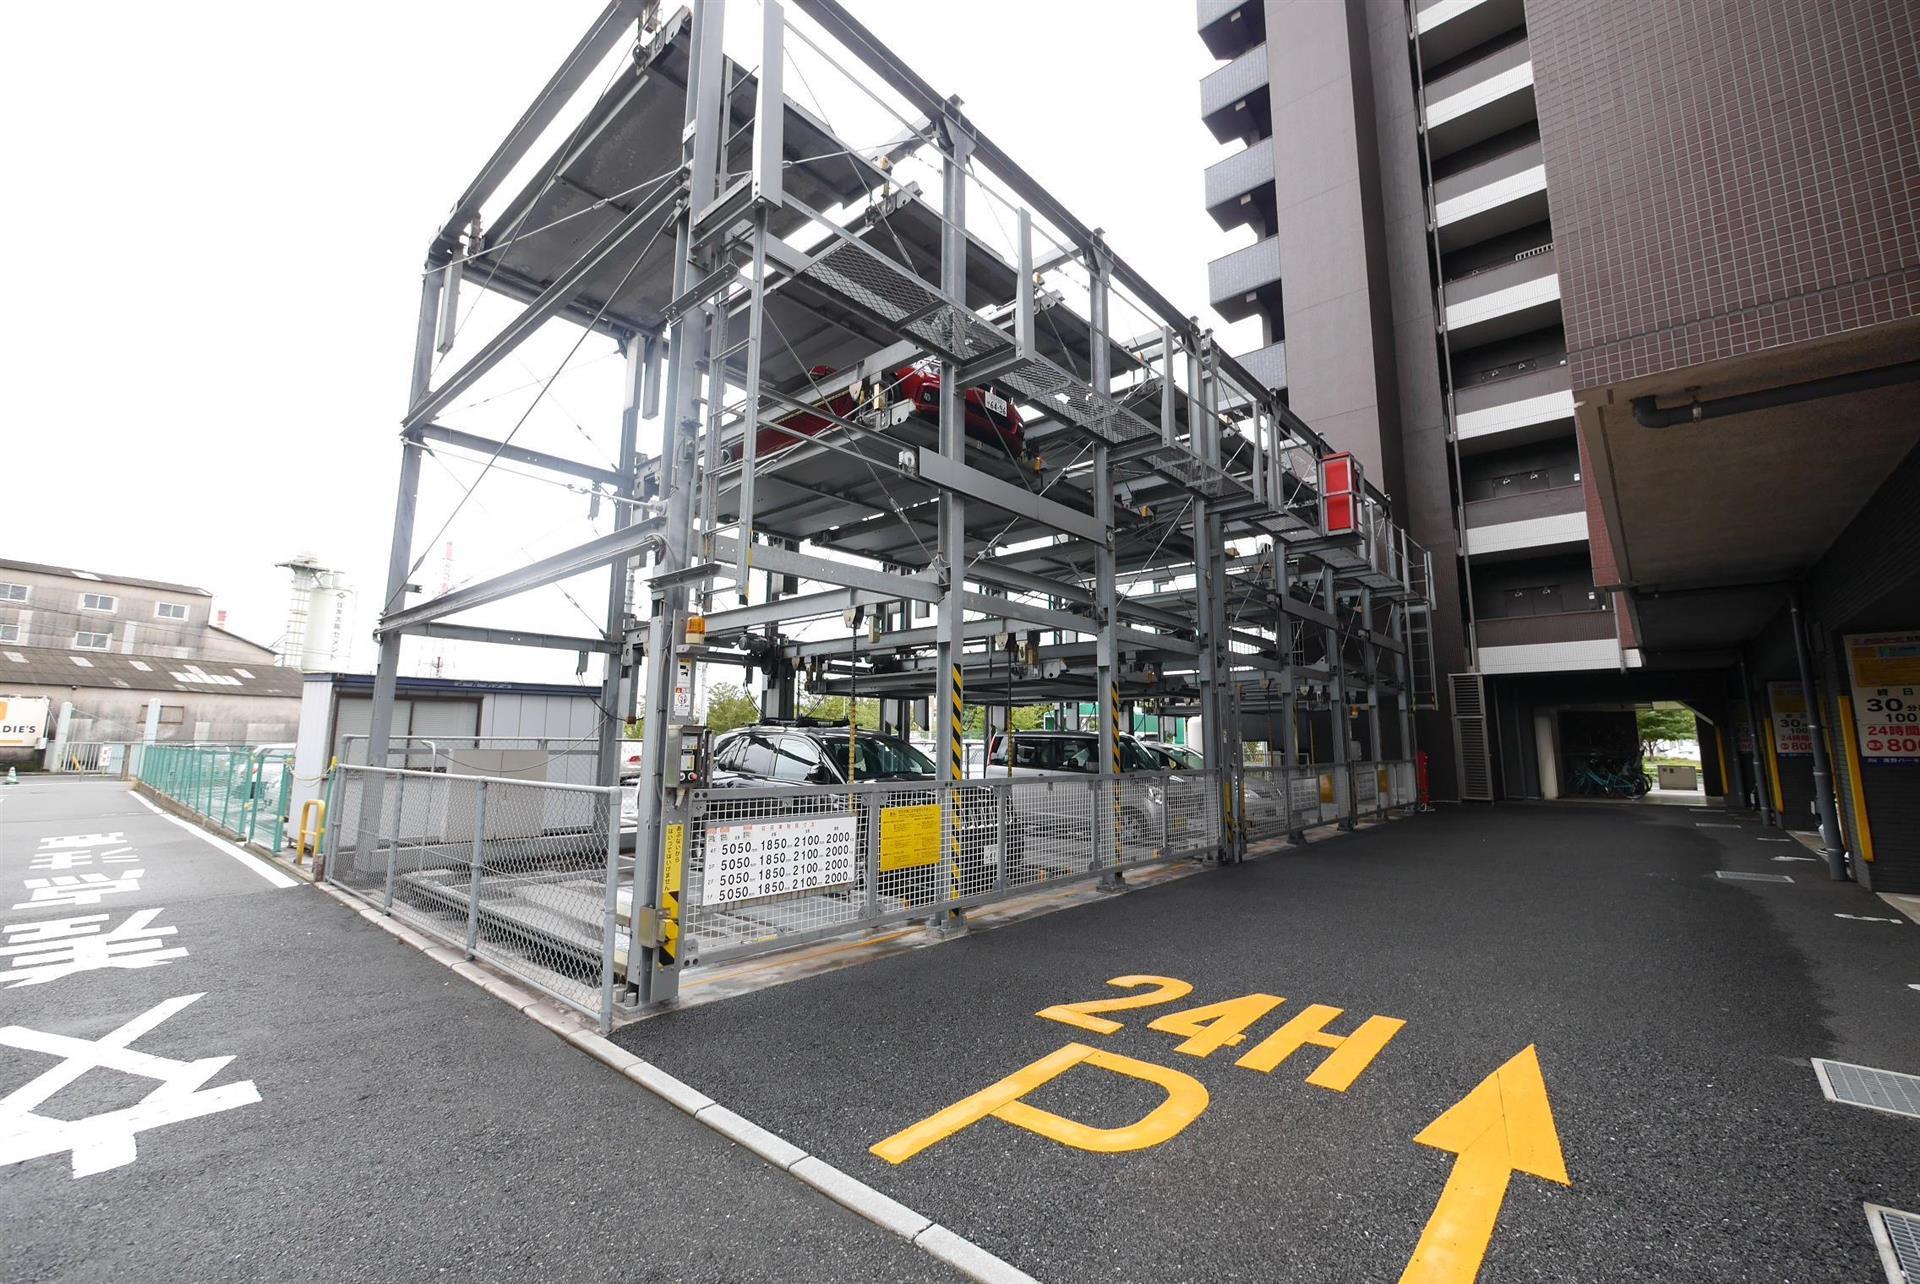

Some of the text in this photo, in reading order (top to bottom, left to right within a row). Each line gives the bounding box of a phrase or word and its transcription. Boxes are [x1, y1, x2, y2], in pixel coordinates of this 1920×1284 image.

[1886, 713, 1917, 723] 100
[1887, 739, 1920, 752] 80
[674, 826, 682, 862] あぶないから
[721, 856, 750, 871] 5050
[759, 852, 786, 866] 1850
[793, 848, 819, 861] 2100
[825, 844, 849, 857] 2000
[722, 841, 752, 855] 5050
[761, 838, 787, 851] 1850
[794, 834, 820, 847] 2100
[826, 831, 850, 843] 2000
[664, 828, 673, 891] はいってはいけません
[720, 871, 750, 886] 5050
[758, 866, 785, 881] 1850
[792, 862, 818, 876] 2100
[825, 857, 849, 871] 2000
[719, 886, 749, 901] 5050
[758, 880, 785, 895] 1850
[792, 875, 818, 889] 2100
[824, 871, 848, 884] 2000
[1035, 974, 1407, 1092] 24H
[868, 1042, 1210, 1166] P
